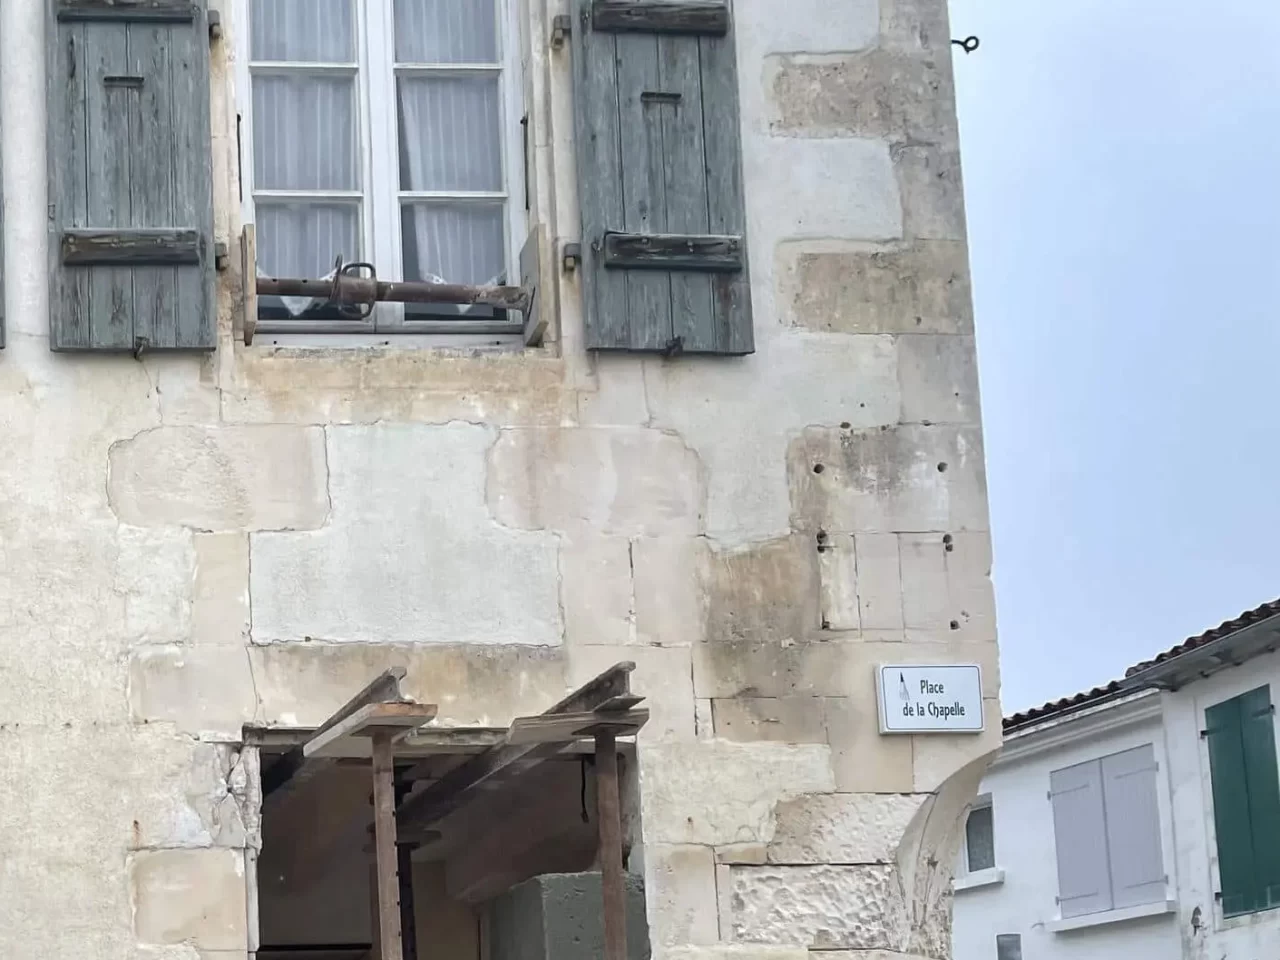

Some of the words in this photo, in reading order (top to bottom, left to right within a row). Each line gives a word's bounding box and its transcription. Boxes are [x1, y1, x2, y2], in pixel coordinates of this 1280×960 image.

[920, 680, 944, 695] Place
[902, 702, 915, 717] de
[916, 702, 925, 717] la
[927, 701, 966, 720] Chapelle
